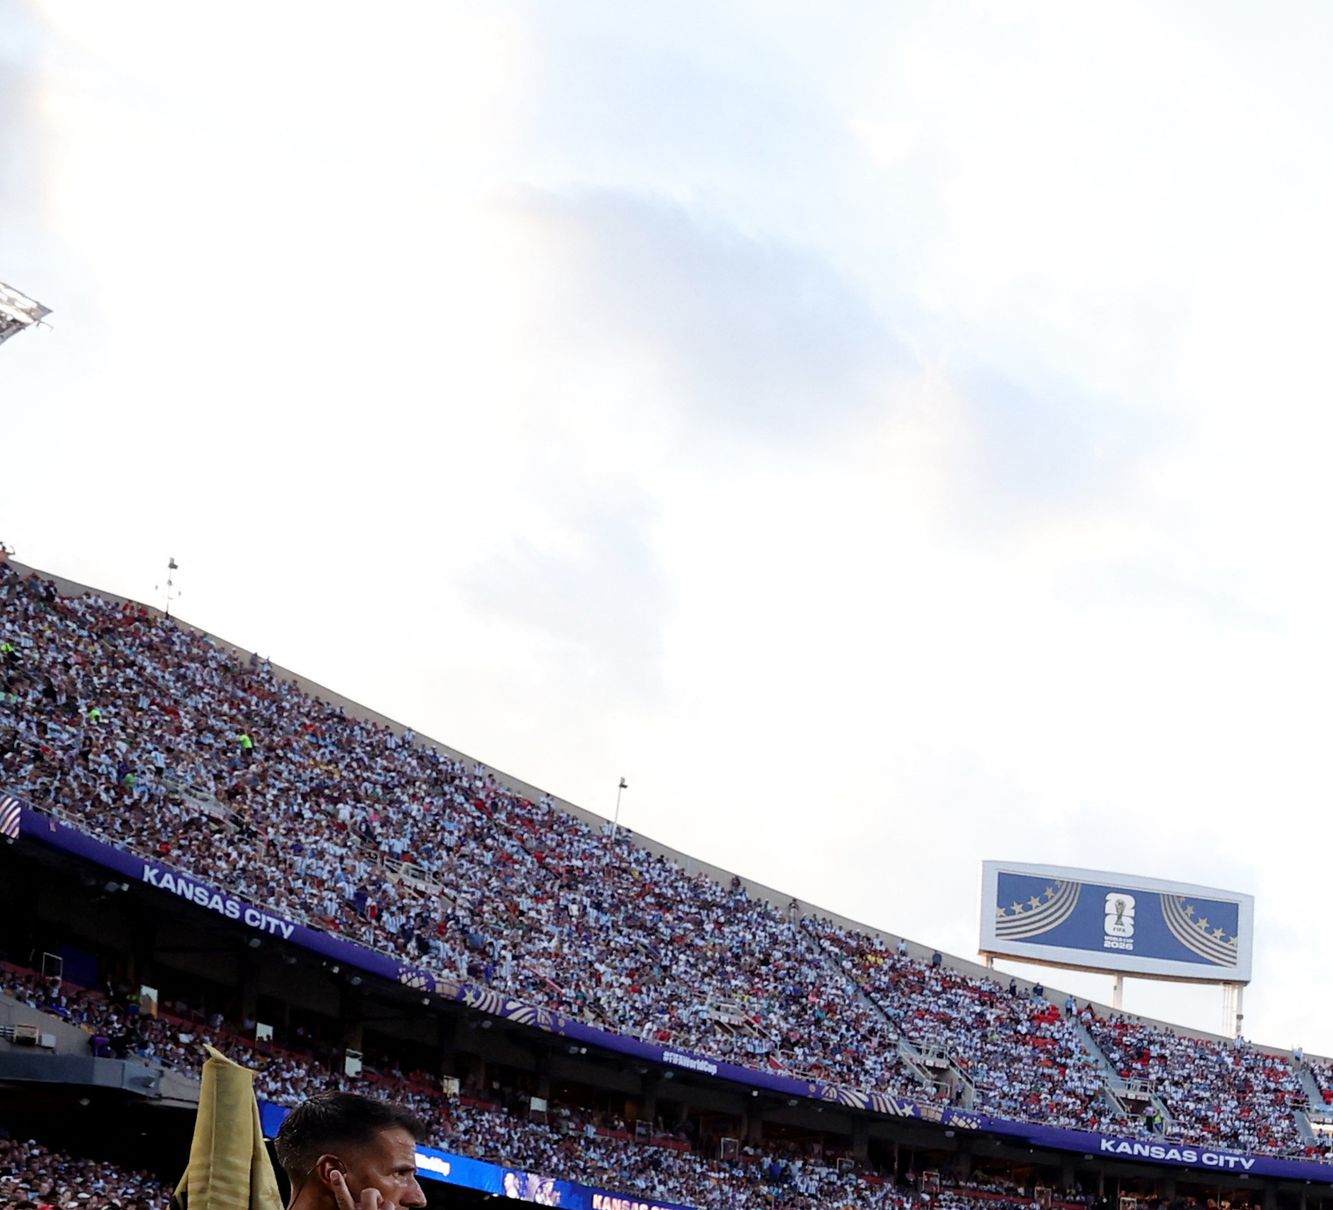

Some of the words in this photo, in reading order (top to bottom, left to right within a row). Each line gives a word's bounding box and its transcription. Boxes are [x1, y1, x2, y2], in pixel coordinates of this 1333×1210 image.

[143, 865, 240, 919] KANSAS
[244, 909, 294, 939] CITY
[1104, 941, 1133, 950] 2026
[1101, 1139, 1197, 1162] KANSAS
[1202, 1153, 1255, 1170] CITY
